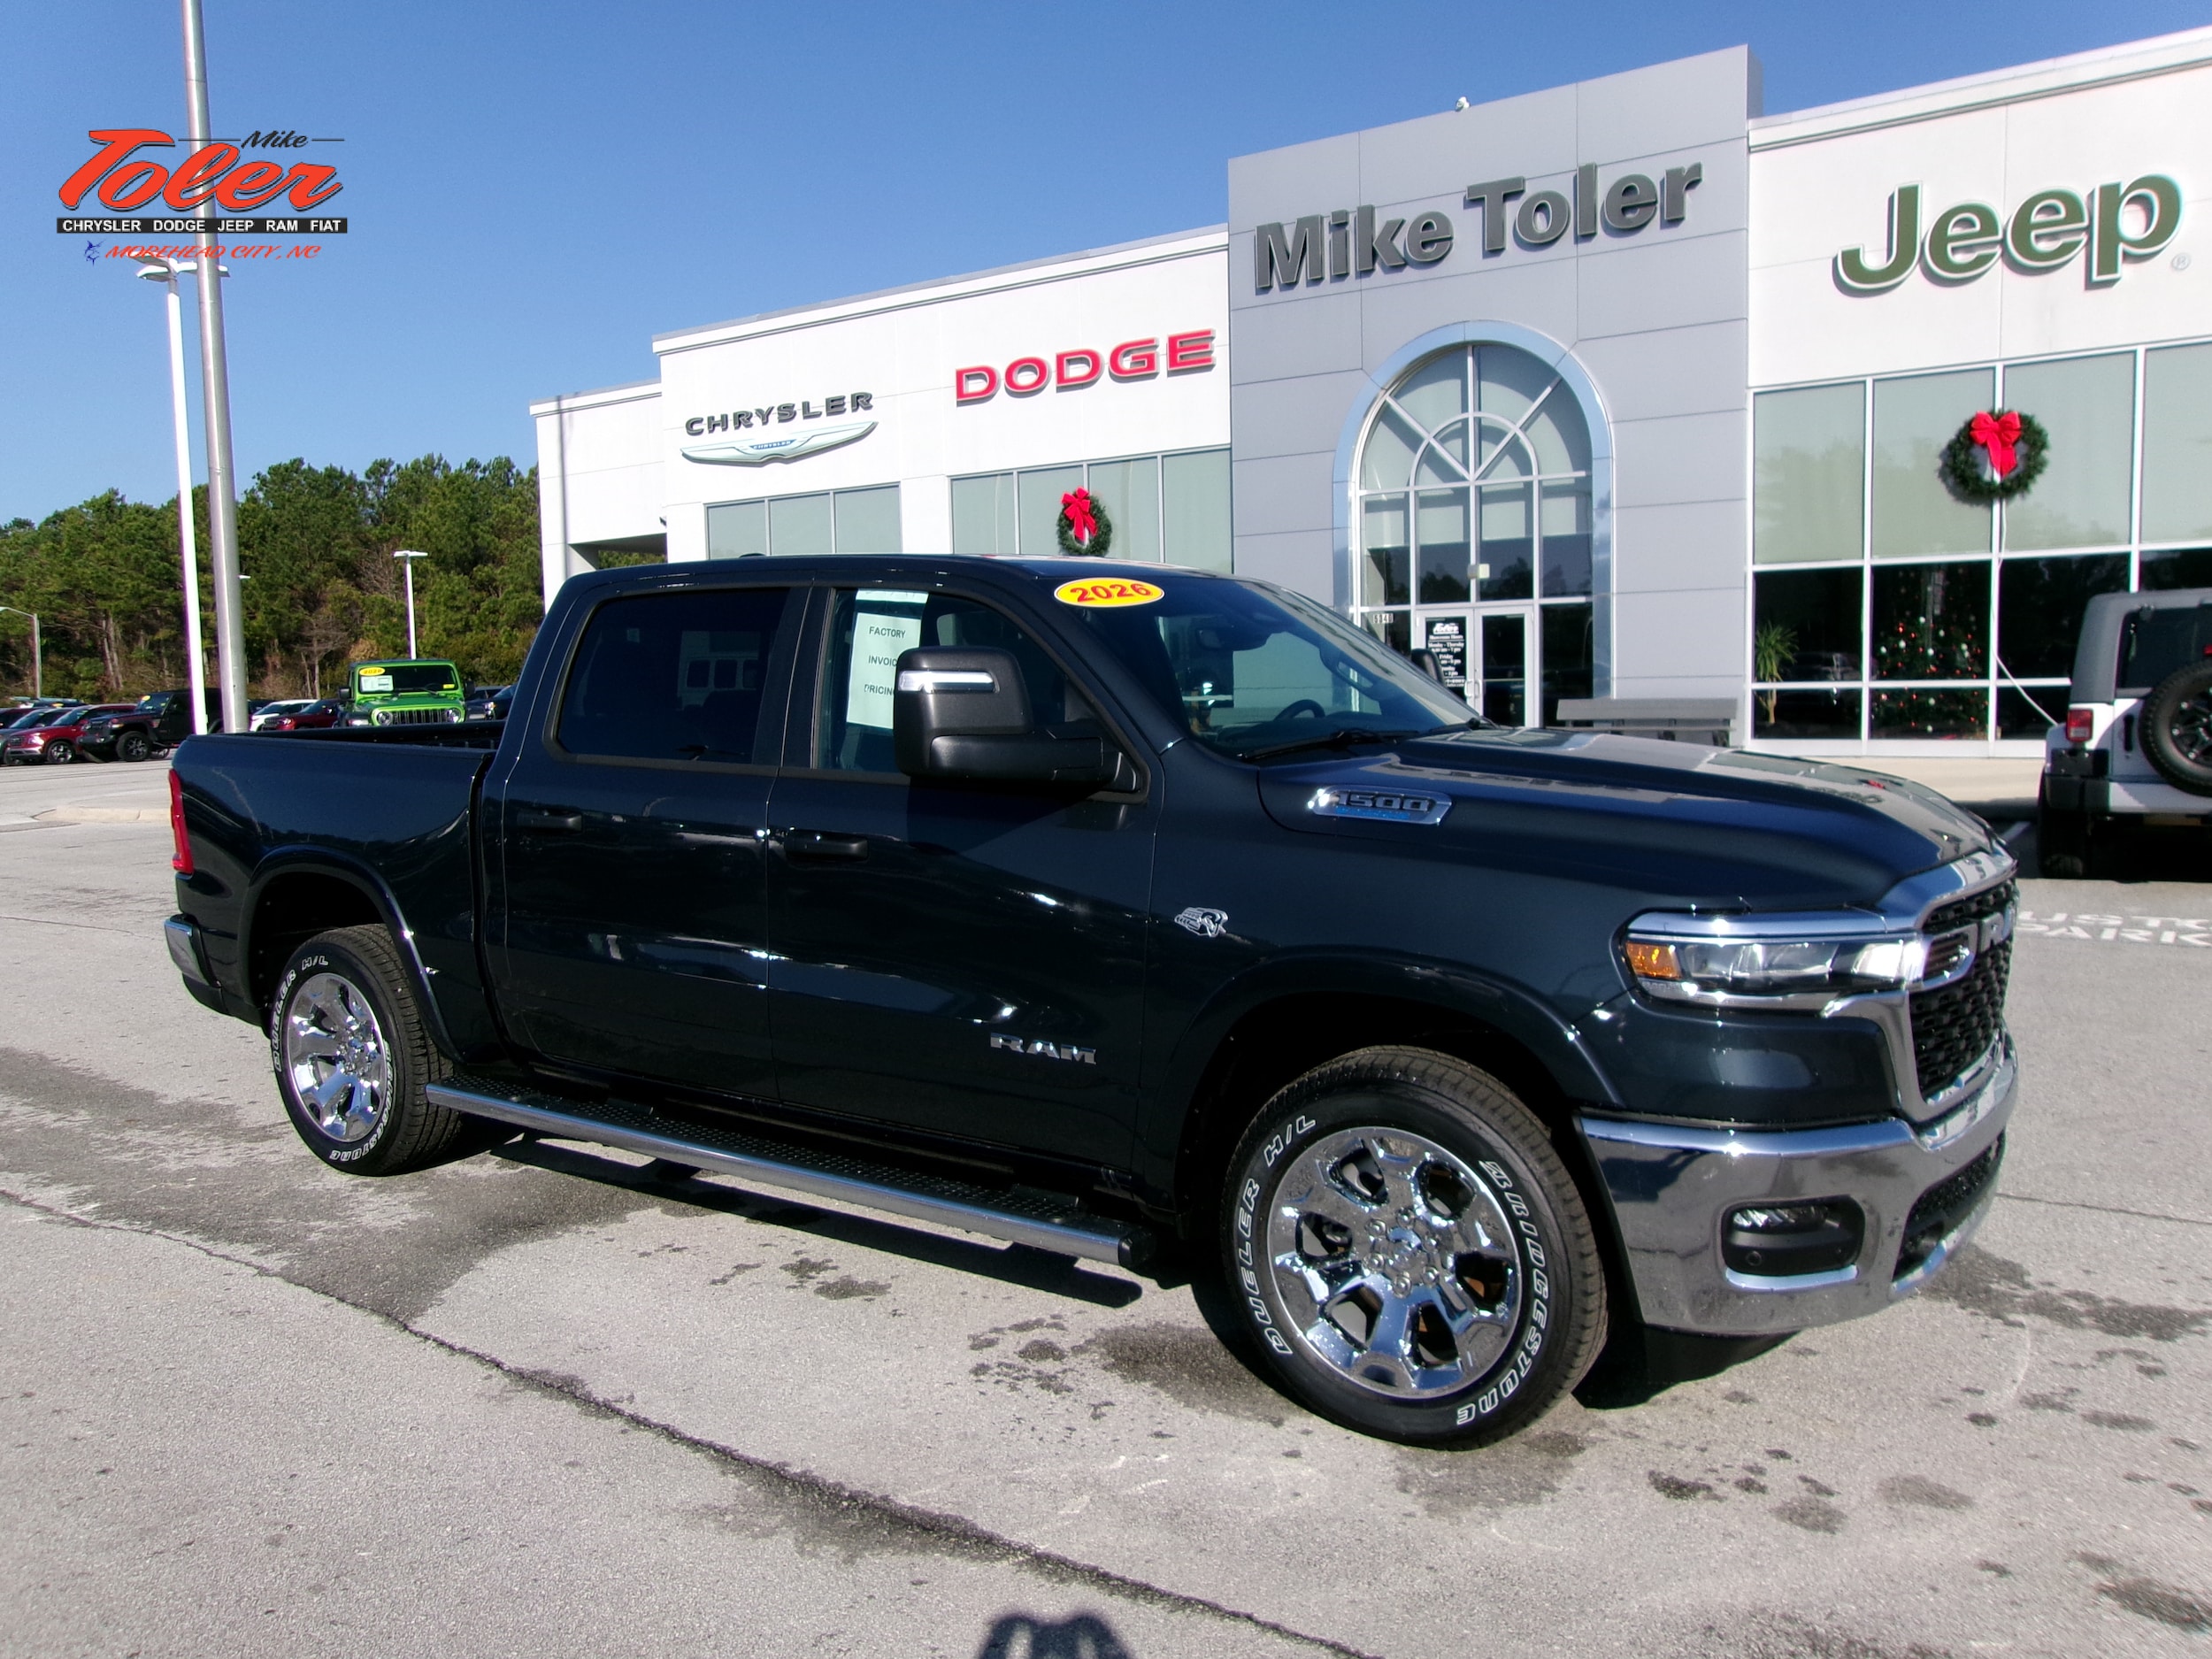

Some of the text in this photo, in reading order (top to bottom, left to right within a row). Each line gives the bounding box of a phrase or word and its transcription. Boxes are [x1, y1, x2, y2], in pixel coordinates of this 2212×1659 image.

[1255, 162, 1703, 294] Mike Toler
[1833, 173, 2185, 297] Jeep
[956, 328, 1216, 406] DODGE
[685, 391, 873, 435] CHRYSLER
[1070, 583, 1152, 603] 2026
[869, 626, 906, 639] FACTORY
[868, 655, 897, 667] INVOIC
[864, 684, 894, 696] PRICIN
[1338, 792, 1430, 812] 1500
[273, 956, 329, 1072] DUELER H/L
[990, 1033, 1097, 1064] RAM
[1238, 1115, 1317, 1355] DUELER H/L
[1457, 1161, 1549, 1425] BRIDGESTONE
